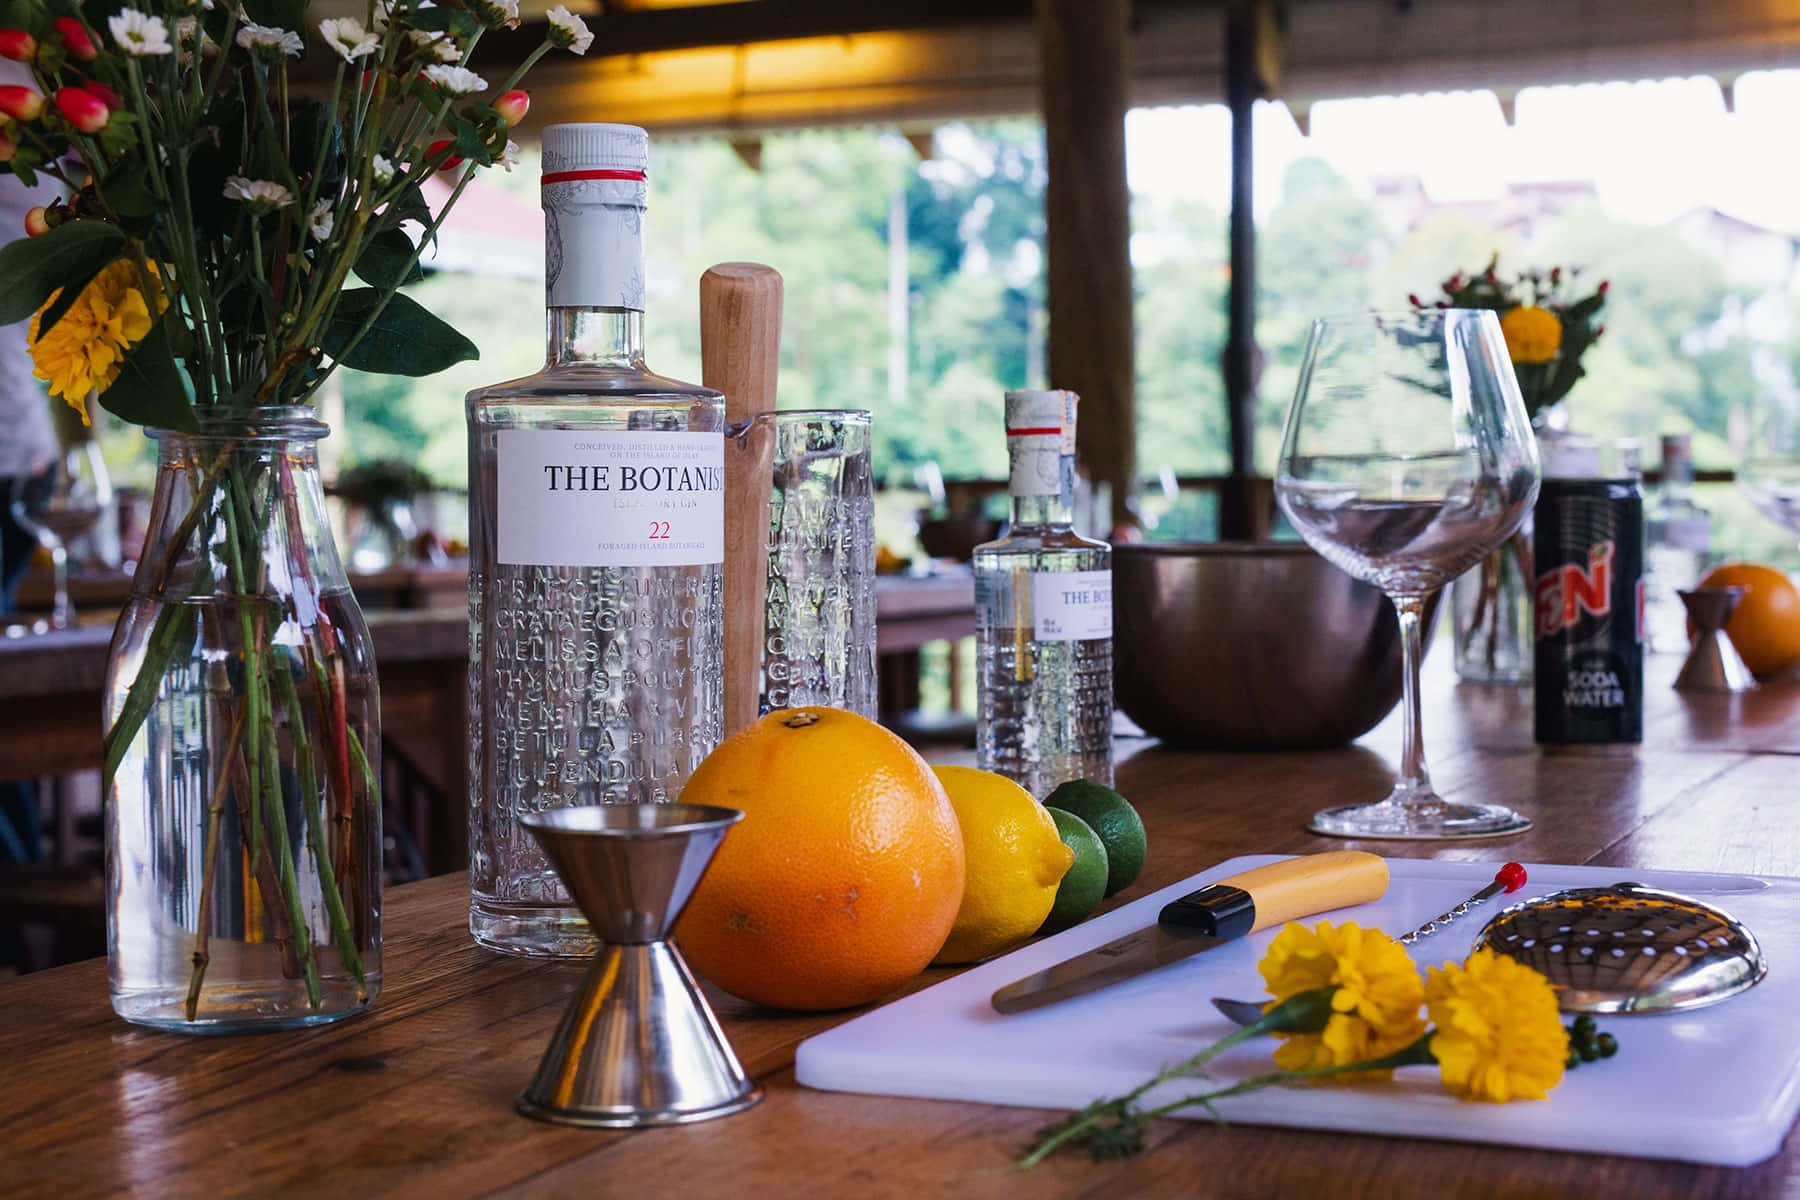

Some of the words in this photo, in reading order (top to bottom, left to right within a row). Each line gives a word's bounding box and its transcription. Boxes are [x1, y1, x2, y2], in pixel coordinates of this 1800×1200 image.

[545, 466, 609, 491] THE
[648, 521, 670, 539] 22
[1062, 591, 1090, 605] THE
[495, 607, 656, 632] CRATAEGUS
[496, 638, 622, 662] MELISSA
[496, 667, 610, 693] THYMUS
[1568, 671, 1619, 688] SODA
[1562, 690, 1624, 708] WATER
[496, 727, 617, 753] BETULA
